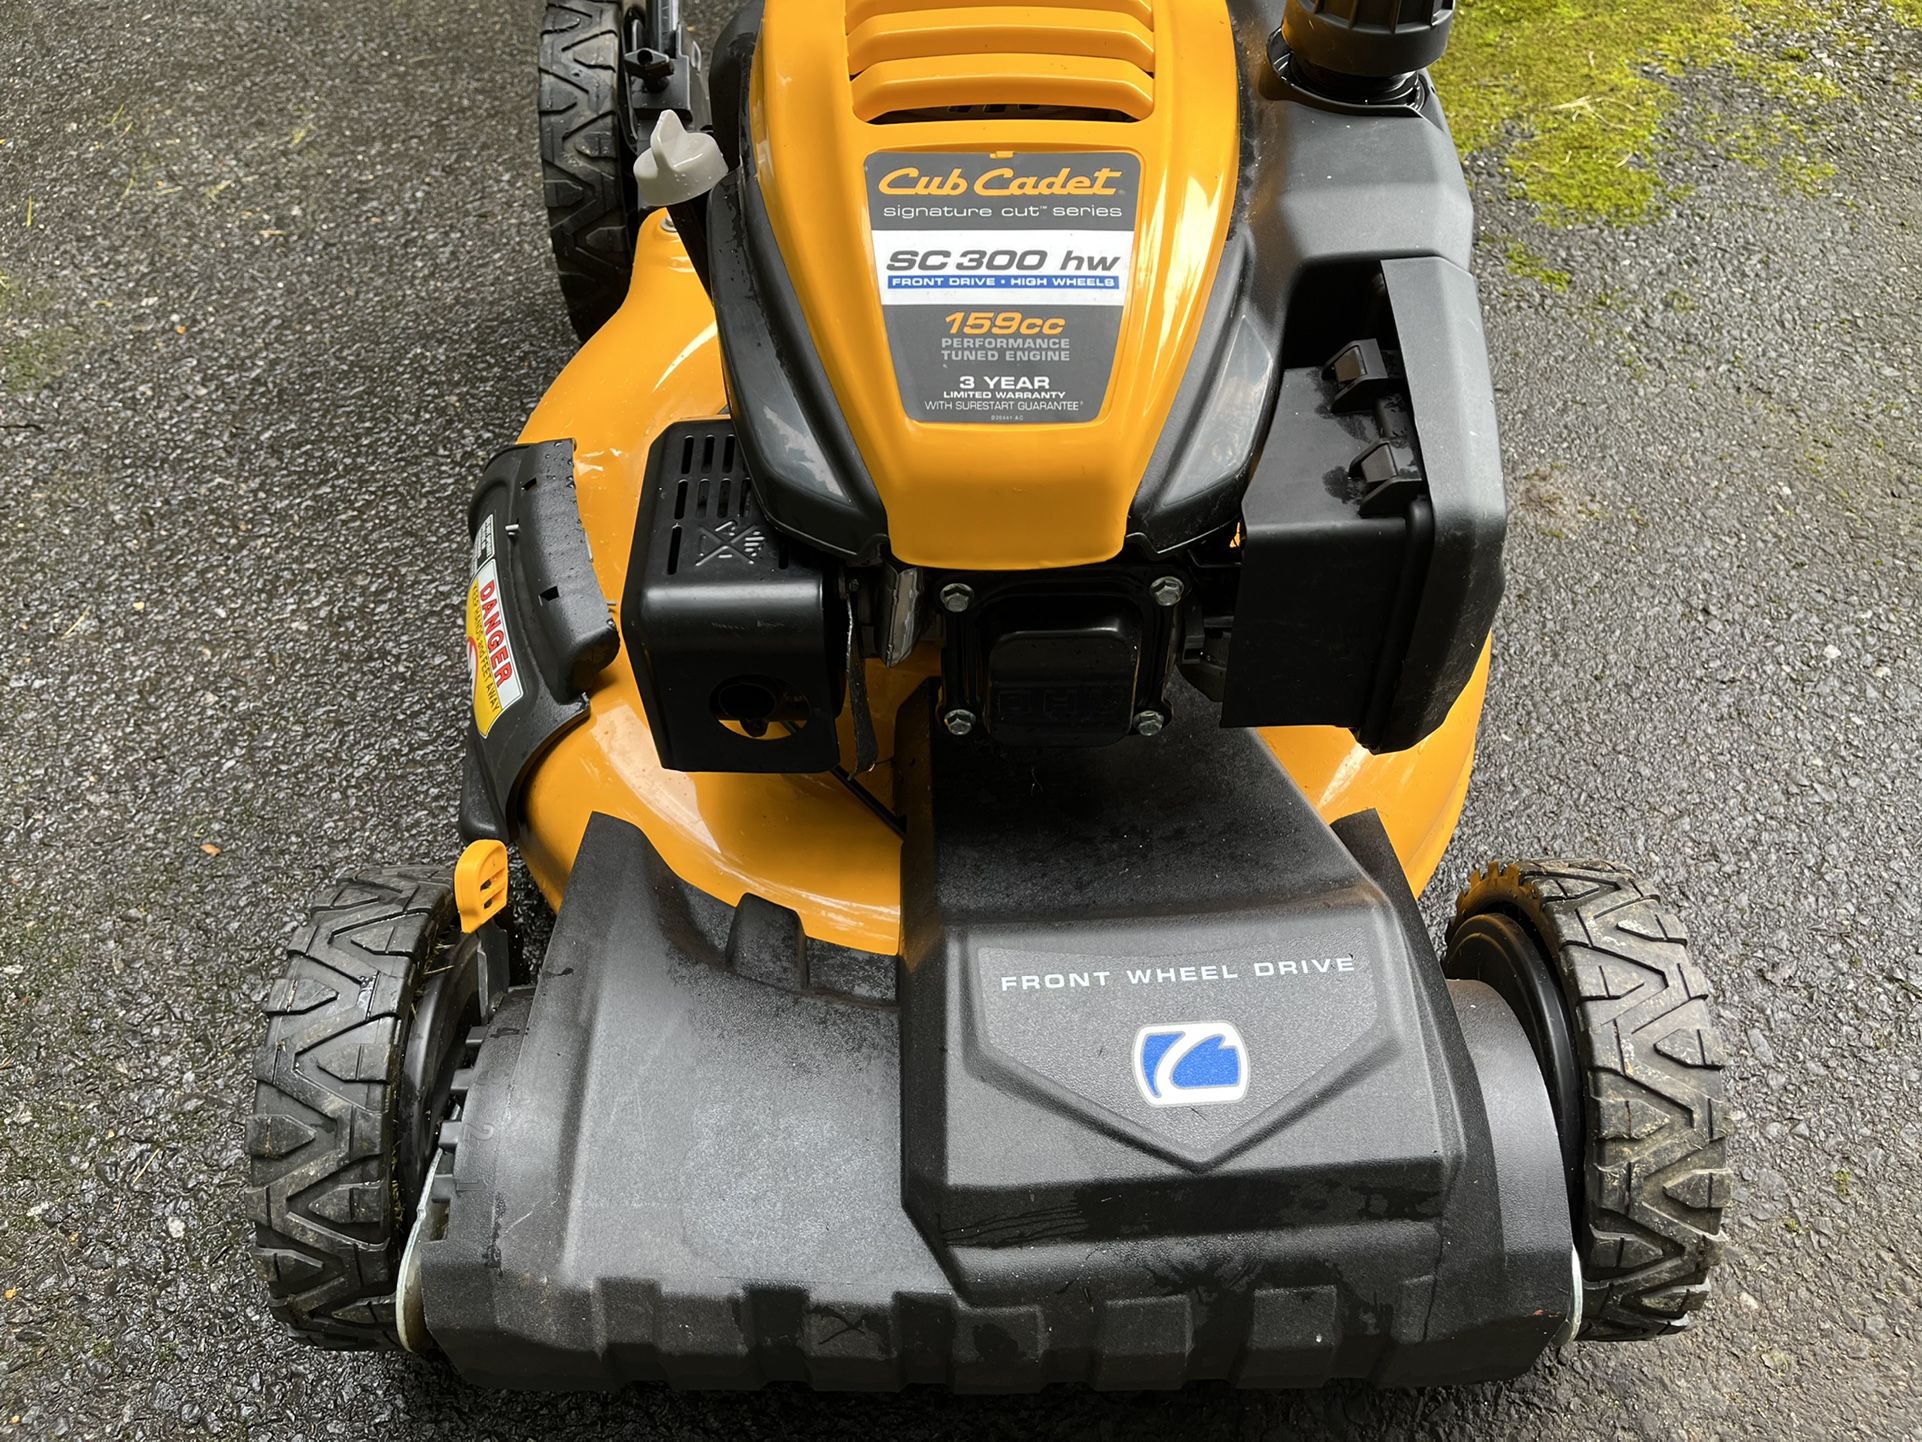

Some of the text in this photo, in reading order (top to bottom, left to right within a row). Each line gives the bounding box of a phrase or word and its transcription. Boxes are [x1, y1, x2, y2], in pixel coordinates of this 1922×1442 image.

[879, 167, 1123, 196] Cub Cadet
[884, 206, 992, 218] signature
[1053, 205, 1122, 217] series
[887, 250, 1121, 271] SC 300 hw
[892, 278, 1114, 286] FRONT DRIVE HIGH WHEELS
[945, 312, 1065, 335] 159cc
[942, 339, 1070, 348] PERFORMANCE
[942, 350, 1070, 361] TUNED ENGINE
[959, 376, 1049, 388] 3 YEAR
[925, 401, 952, 410] WITH
[956, 401, 1014, 410] SURESTART
[479, 579, 513, 687] DANGER
[473, 608, 482, 641] HANDS
[479, 656, 491, 684] FEET
[485, 683, 499, 712] AWAY
[1001, 957, 1354, 991] FRONT WHEEL DRIVE
